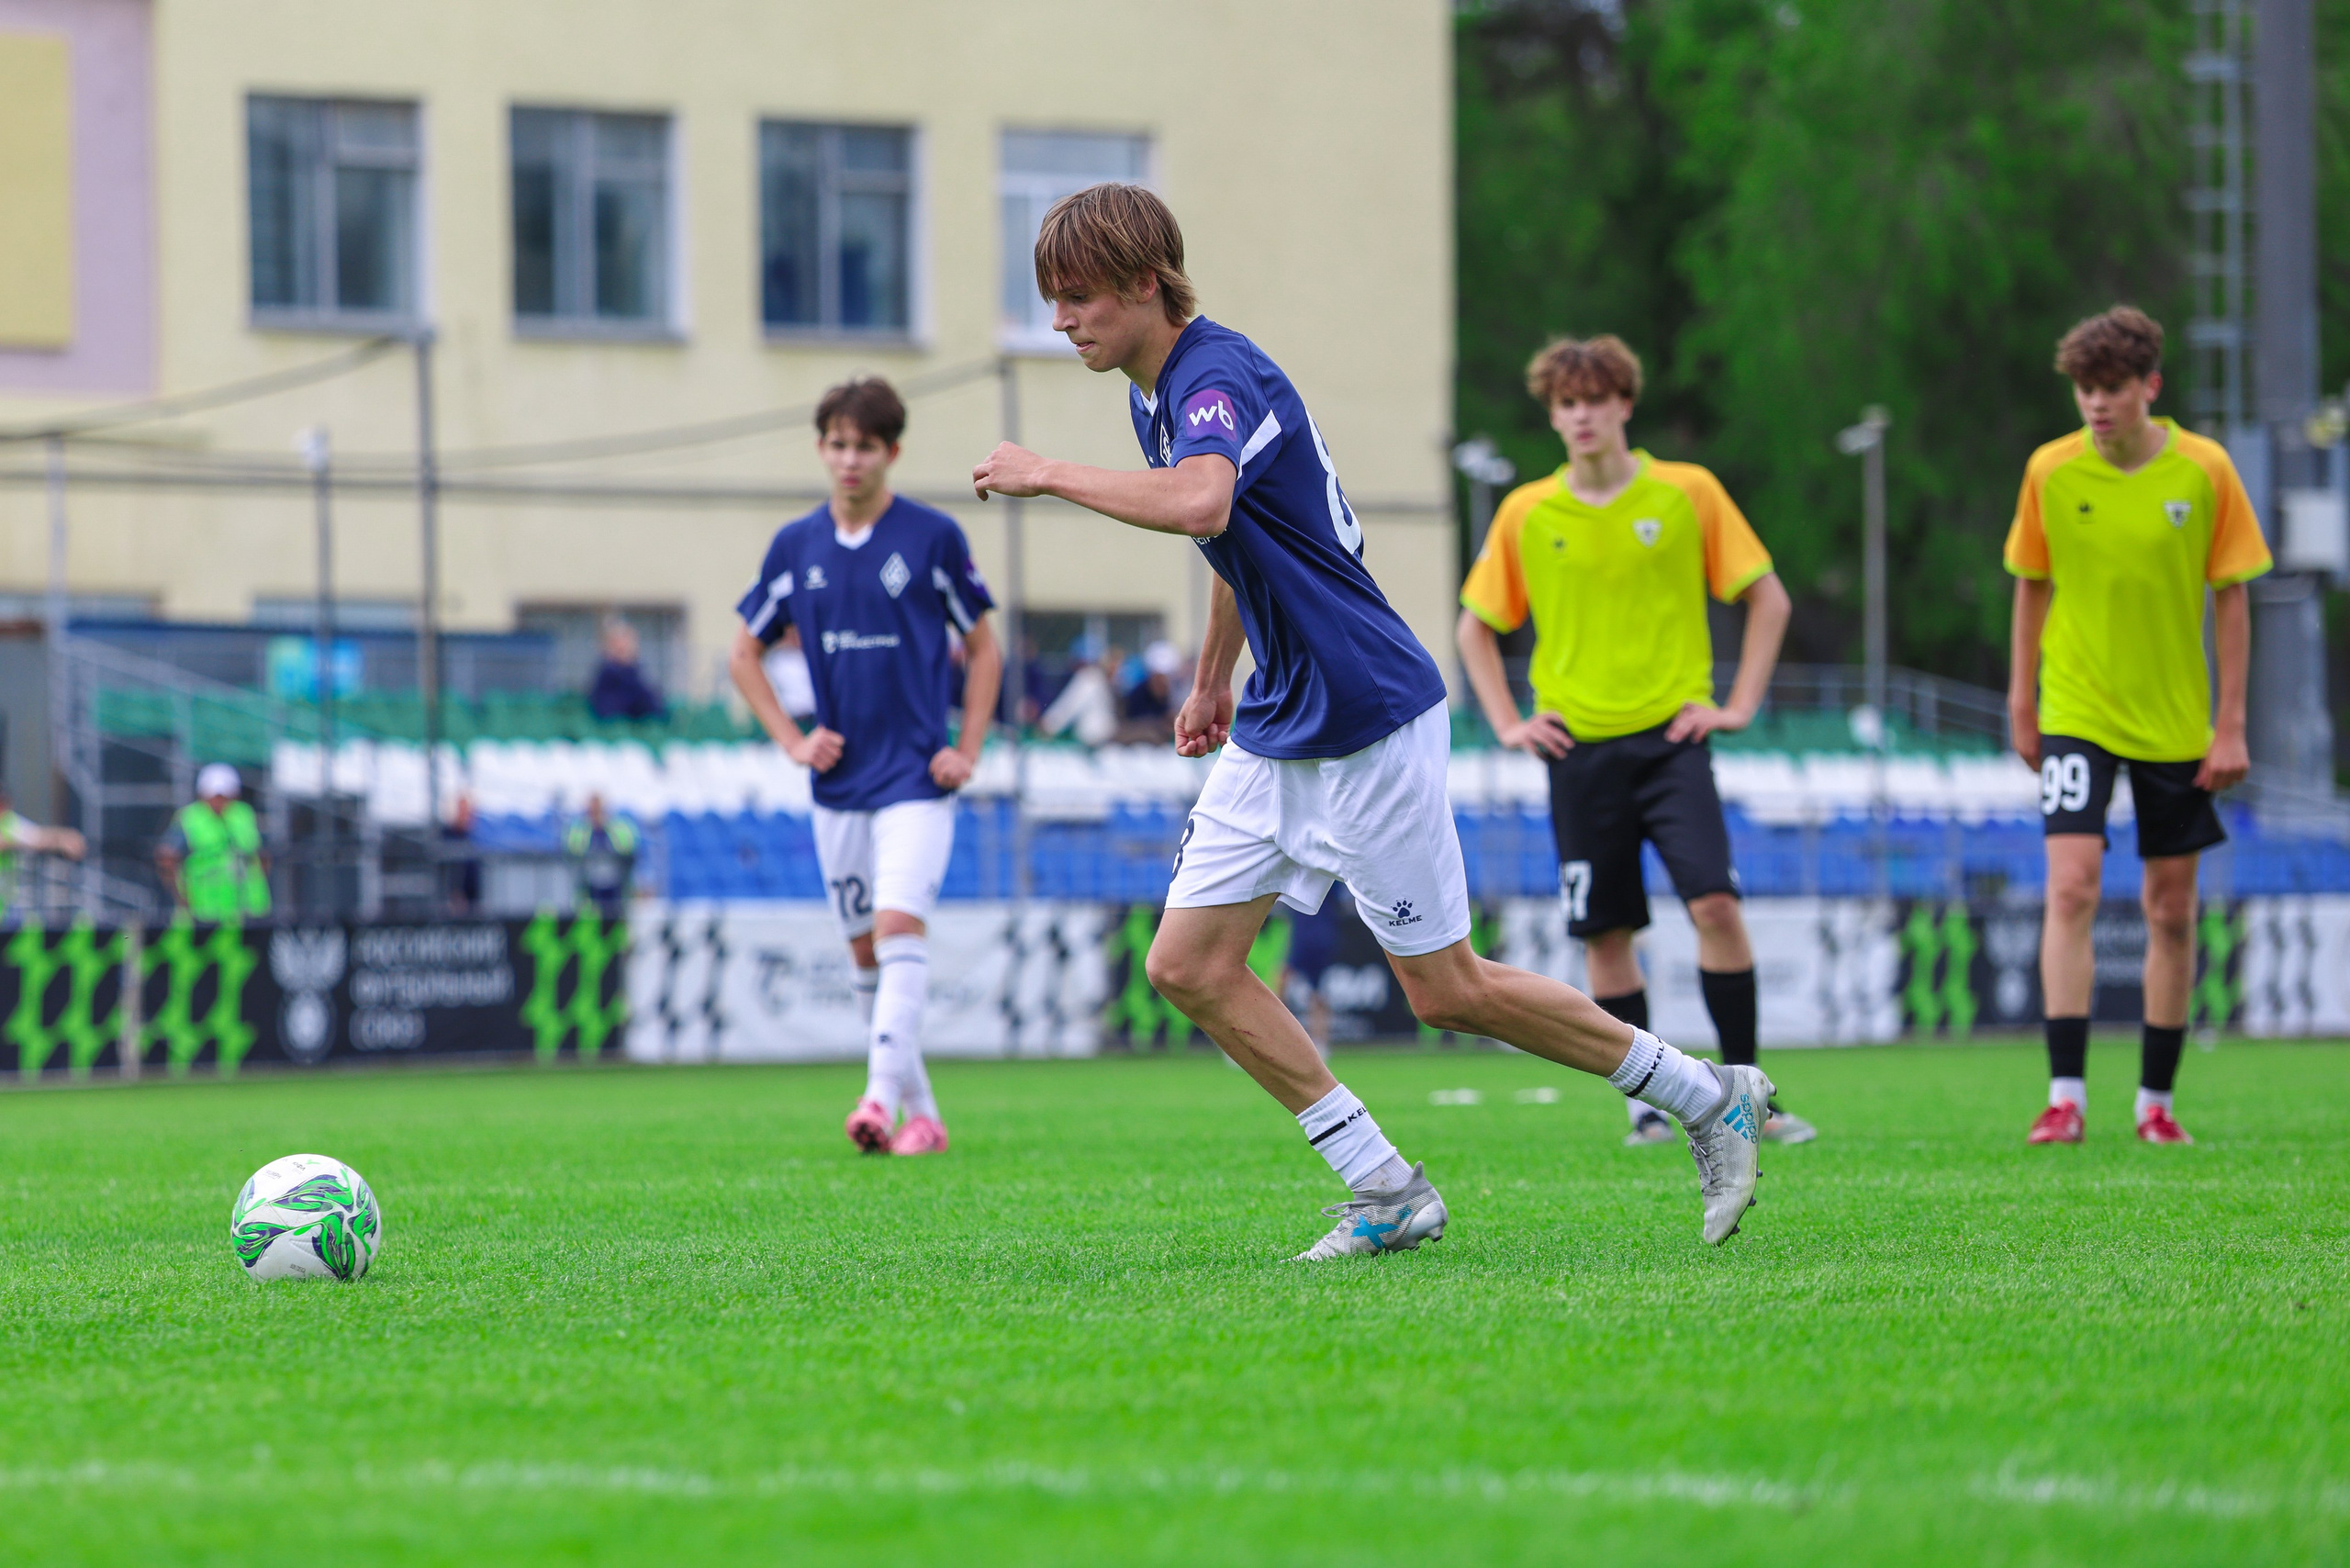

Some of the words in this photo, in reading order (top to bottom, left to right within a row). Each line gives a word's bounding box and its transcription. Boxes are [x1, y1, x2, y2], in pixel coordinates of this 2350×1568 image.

[1188, 399, 1234, 431] wb
[2041, 753, 2091, 816] 99
[1388, 914, 1423, 926] KELME
[1740, 1093, 1758, 1144] adidas
